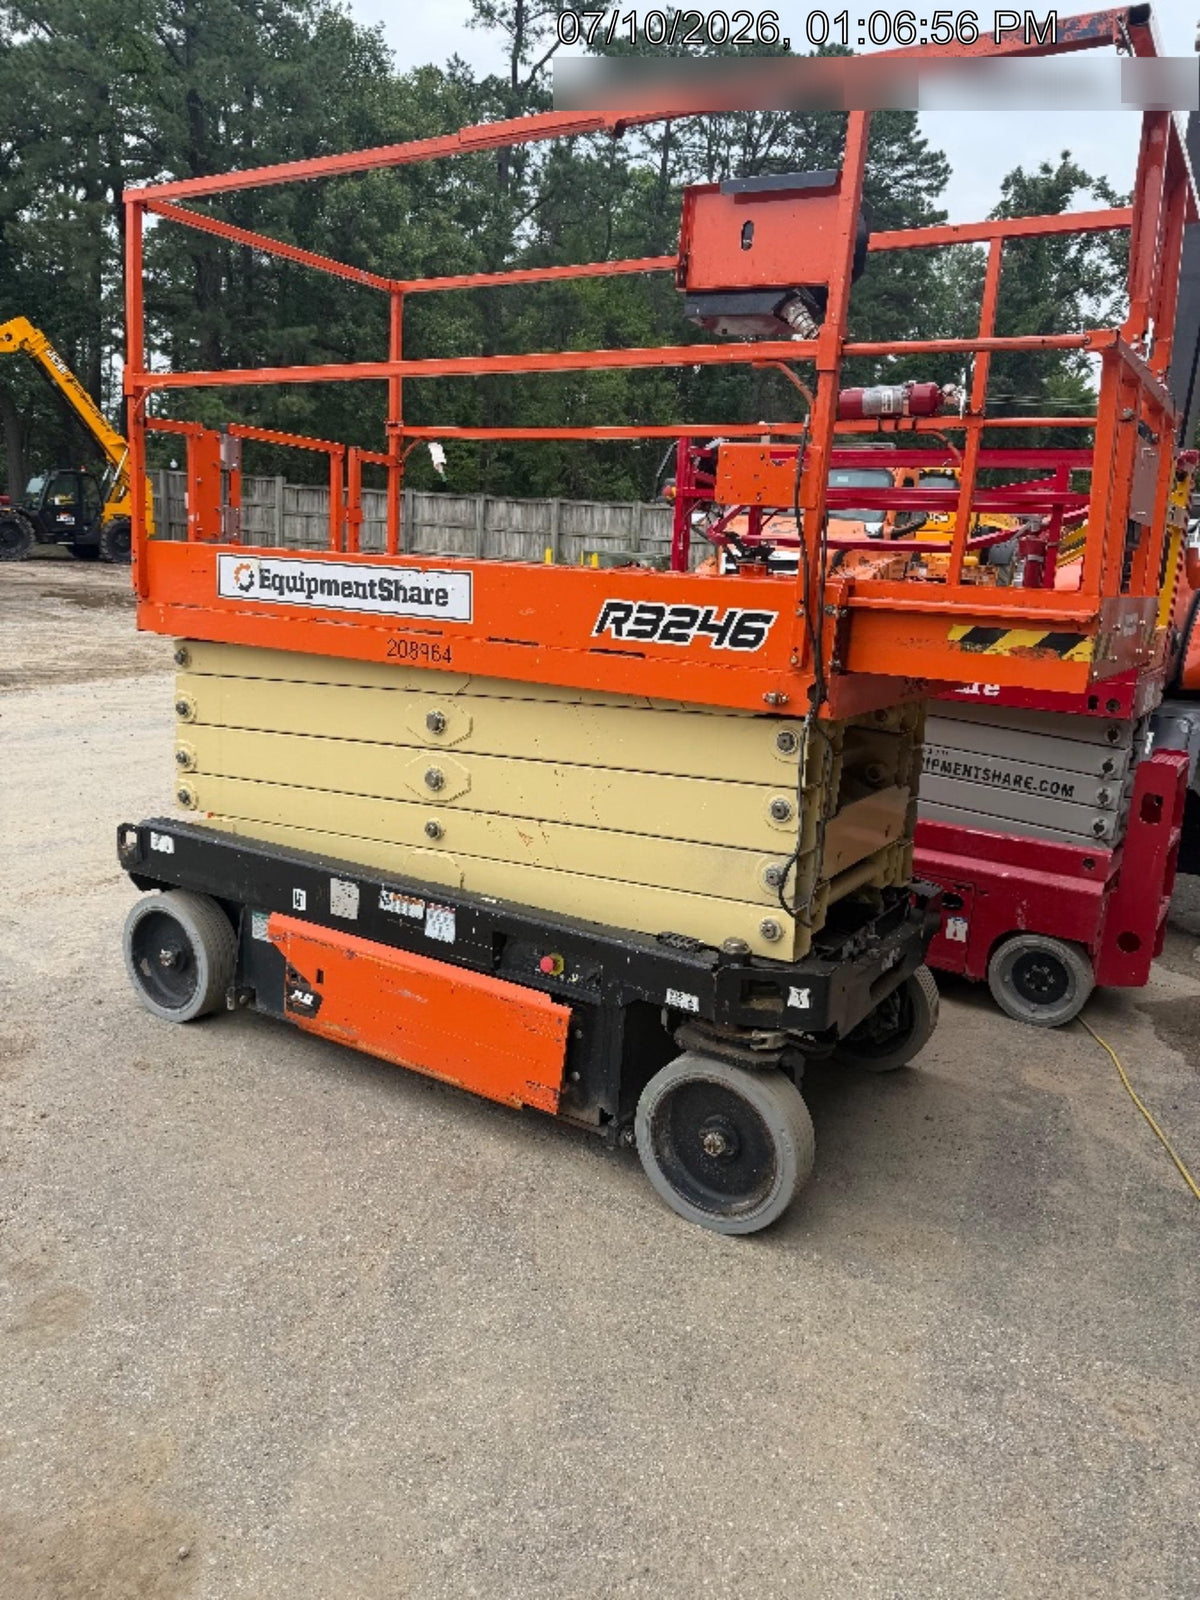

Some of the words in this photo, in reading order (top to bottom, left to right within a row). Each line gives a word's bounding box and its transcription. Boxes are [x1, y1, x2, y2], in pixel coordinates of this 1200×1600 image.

[258, 567, 449, 607] EquipmentShare
[590, 599, 779, 651] R3246
[387, 638, 452, 663] 208964
[922, 757, 1075, 798] IPMENTSHARE.COM
